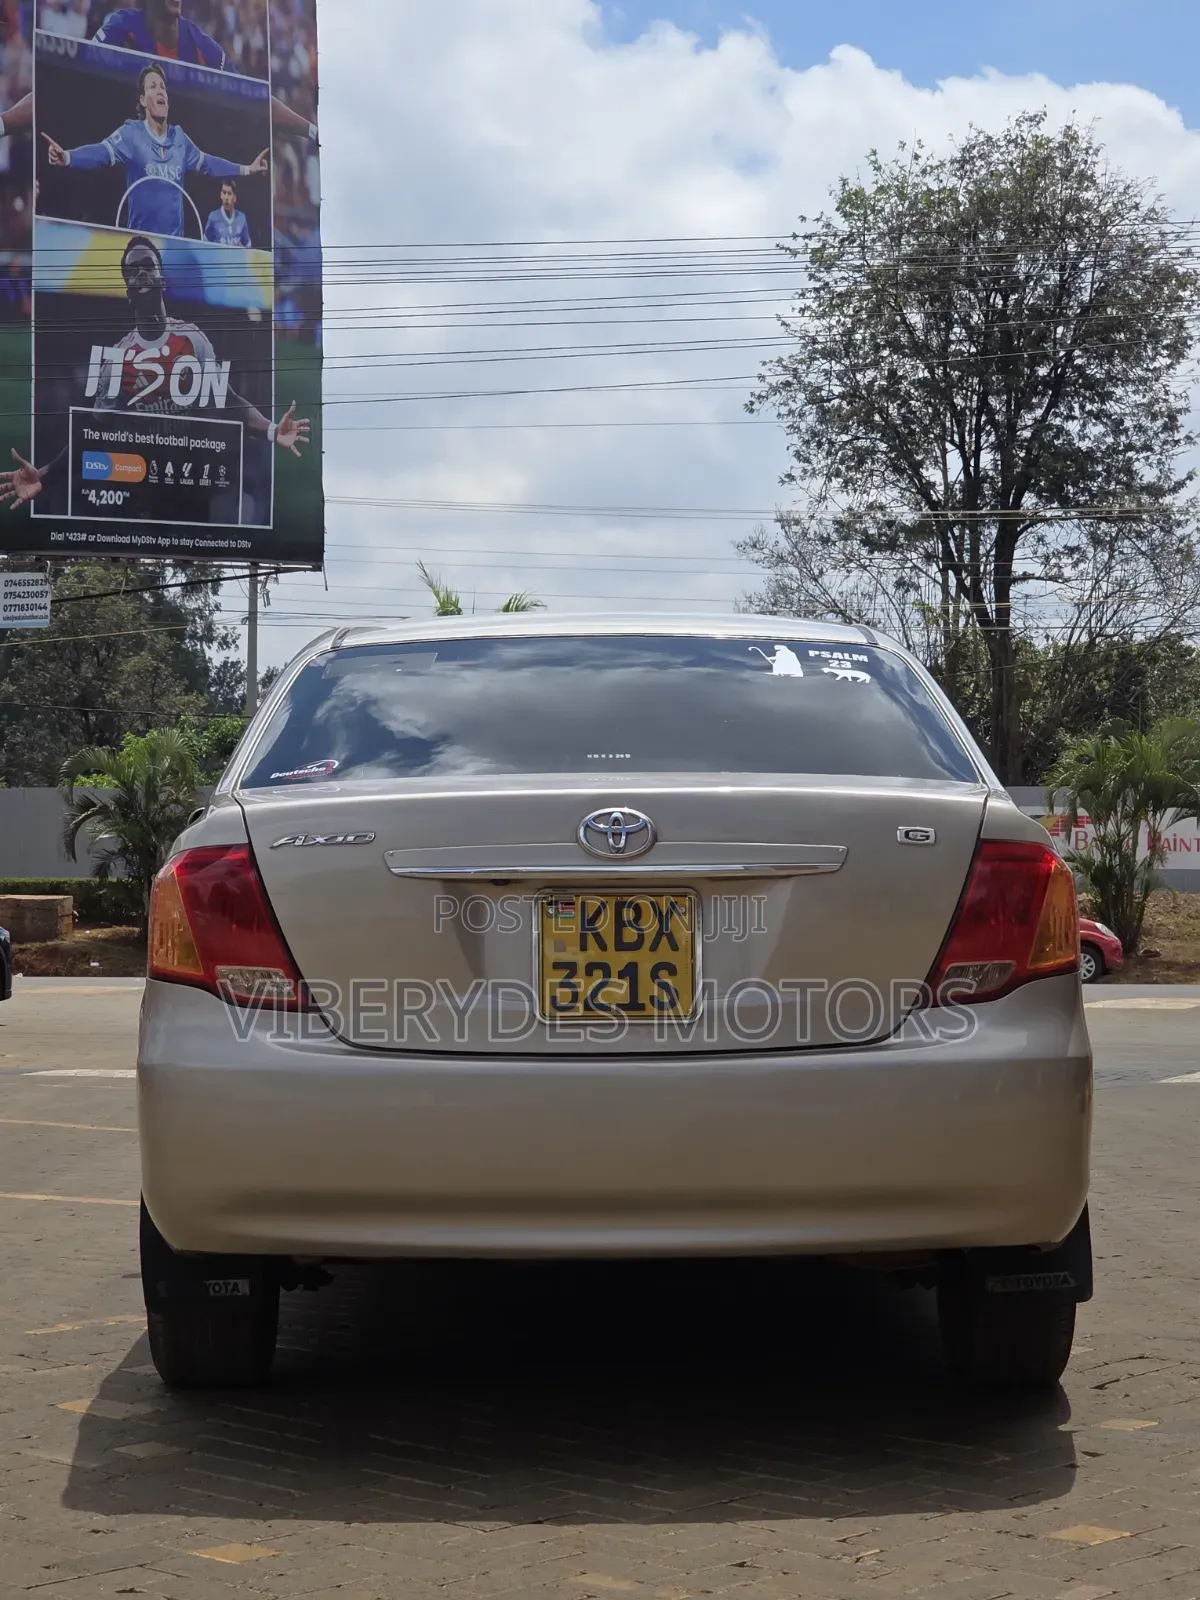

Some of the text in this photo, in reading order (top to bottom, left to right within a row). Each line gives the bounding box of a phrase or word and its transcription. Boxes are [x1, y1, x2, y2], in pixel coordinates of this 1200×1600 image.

[170, 355, 231, 409] ON
[83, 428, 226, 453] The world's best football package
[115, 464, 142, 475] Compact
[88, 489, 123, 506] 4,200
[50, 532, 65, 541] Dial
[96, 534, 131, 543] Download
[131, 535, 156, 546] MyDStv
[157, 536, 171, 547] App
[172, 537, 179, 546] to
[180, 538, 194, 548] stay
[194, 538, 229, 548] Connected
[230, 540, 237, 548] to
[237, 540, 252, 548] DStv
[3, 590, 49, 599] 0754230057
[3, 603, 48, 612] 0771830144
[808, 650, 869, 662] PSALM
[828, 660, 852, 669] 23
[904, 828, 931, 842] G
[580, 900, 679, 952] KBX
[551, 961, 680, 1013] 321S
[1014, 1275, 1070, 1289] TOYOTA
